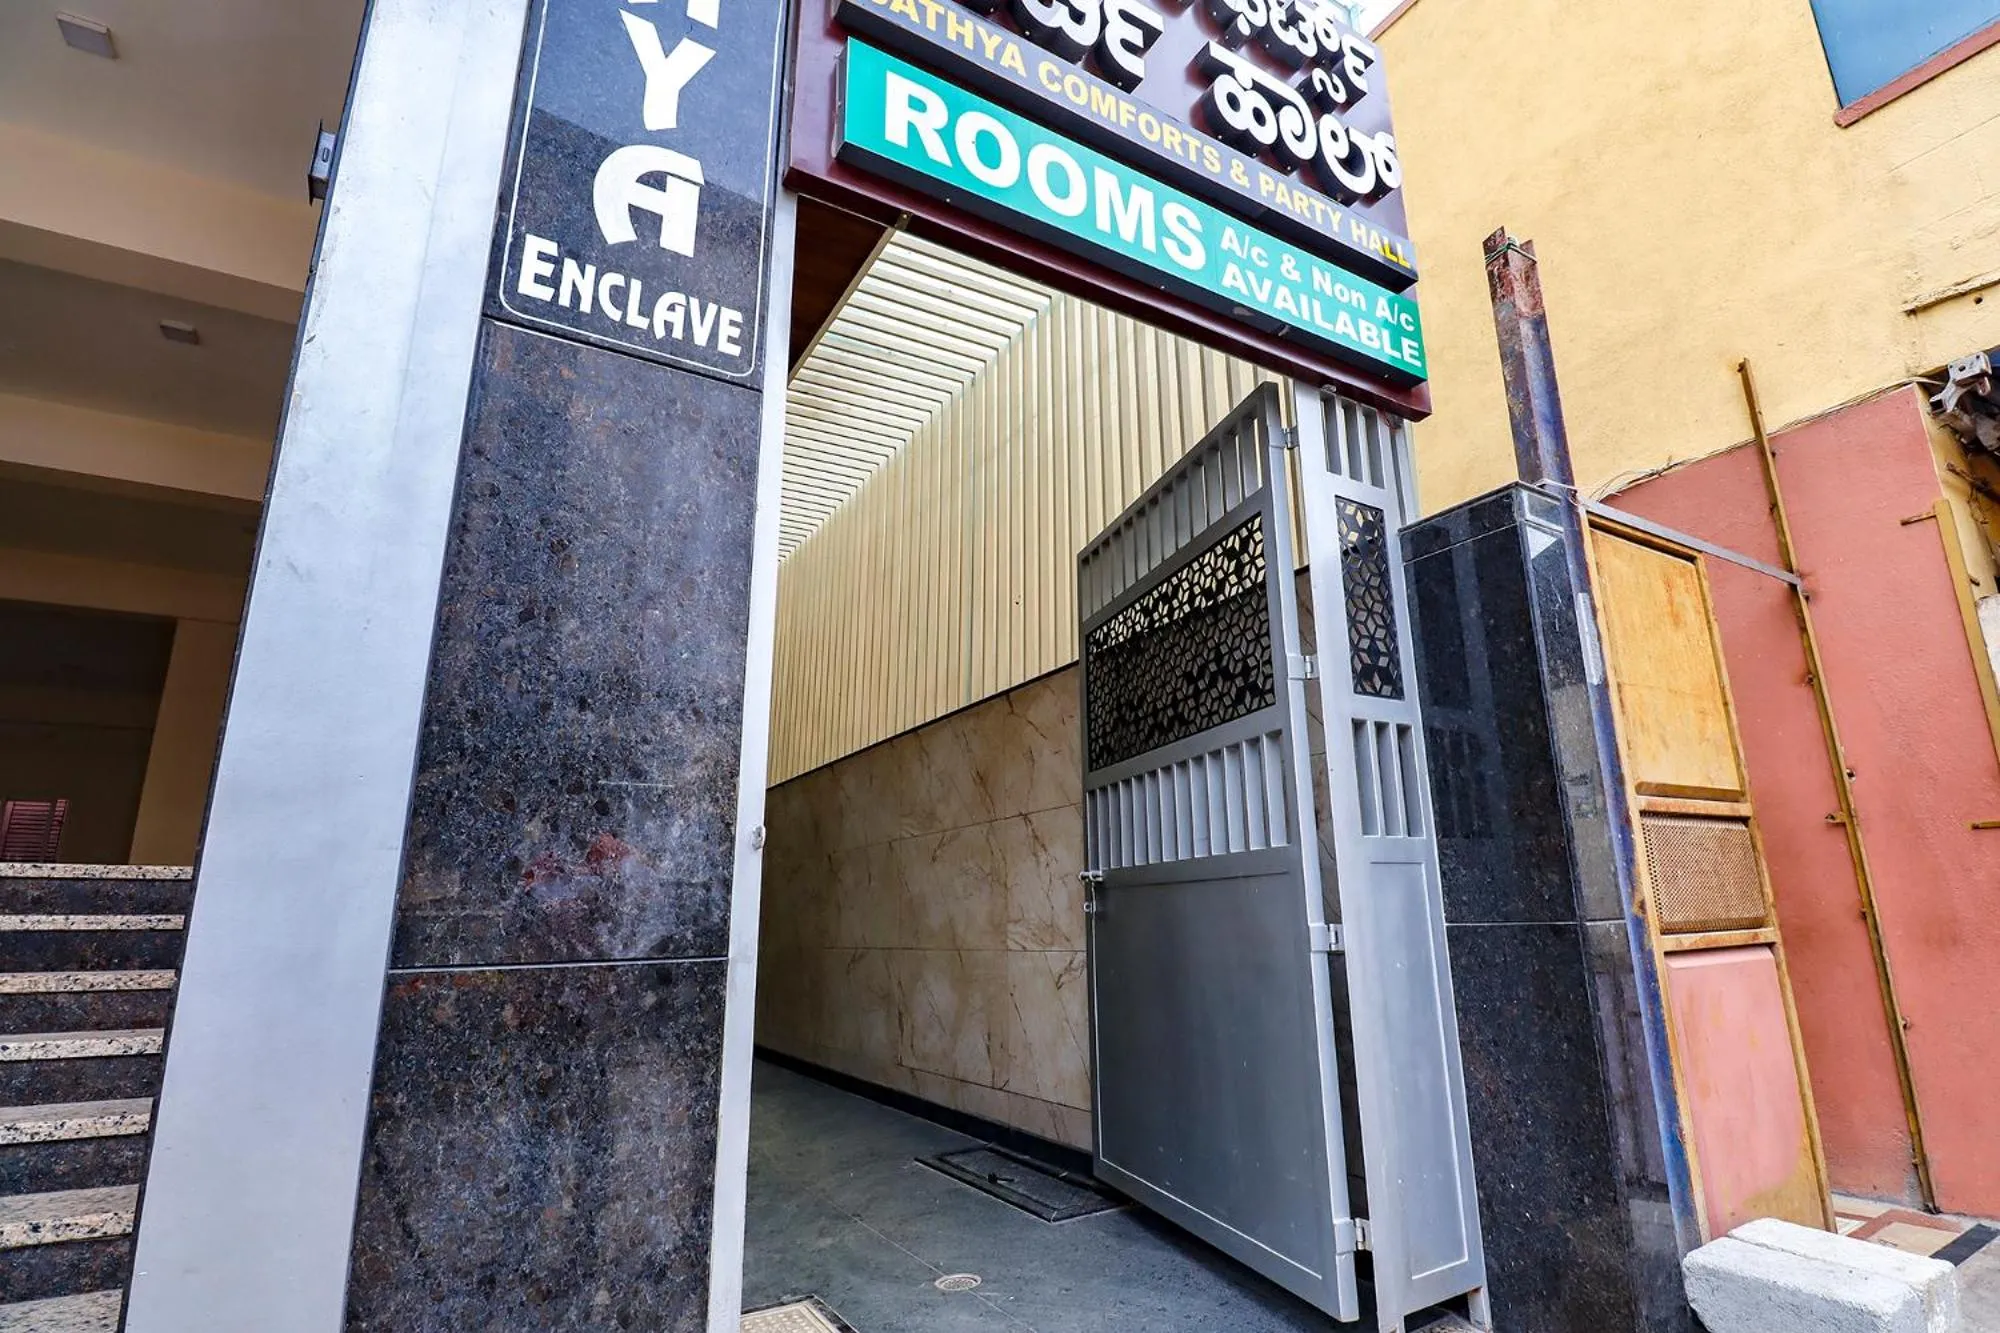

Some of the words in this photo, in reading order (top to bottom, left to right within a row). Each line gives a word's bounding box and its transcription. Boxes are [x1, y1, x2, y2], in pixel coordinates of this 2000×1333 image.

[593, 0, 719, 258] YA
[871, 0, 1027, 78] ATHYA
[1038, 61, 1221, 174] COMFORTS
[1229, 157, 1250, 189] &
[1258, 171, 1343, 234] PARTY
[1351, 219, 1412, 269] HALL
[884, 70, 1206, 272] ROOMS
[517, 233, 744, 357] ENCLAVE
[1221, 262, 1422, 367] AVAILABLE
[1280, 253, 1300, 283] &
[1312, 265, 1367, 312] Non
